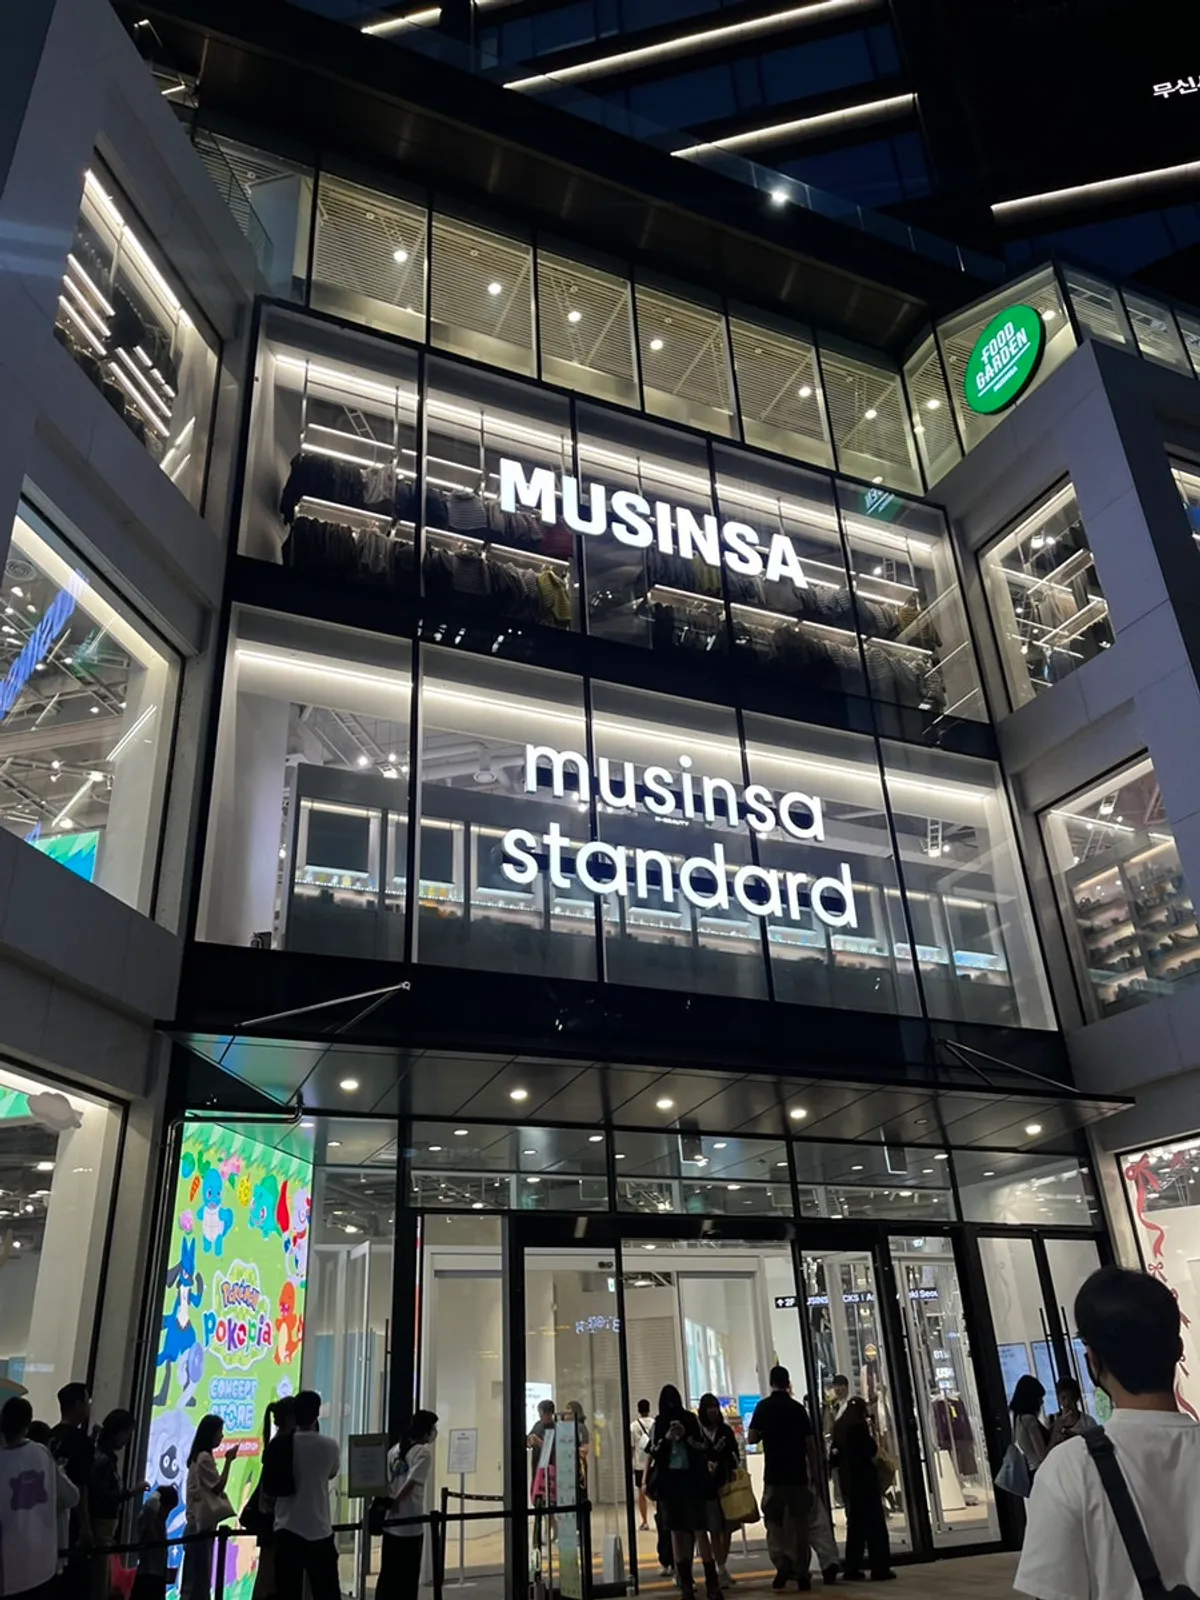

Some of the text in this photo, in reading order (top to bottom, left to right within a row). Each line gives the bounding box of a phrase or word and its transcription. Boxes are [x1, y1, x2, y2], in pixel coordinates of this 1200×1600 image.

[976, 327, 1028, 390] GARDEN
[981, 322, 1015, 363] FOOD
[500, 457, 809, 589] MUSINSA
[525, 744, 825, 841] musinsa
[502, 822, 858, 928] standard
[203, 1311, 271, 1352] Pokopia
[210, 1378, 258, 1400] CONCEPT
